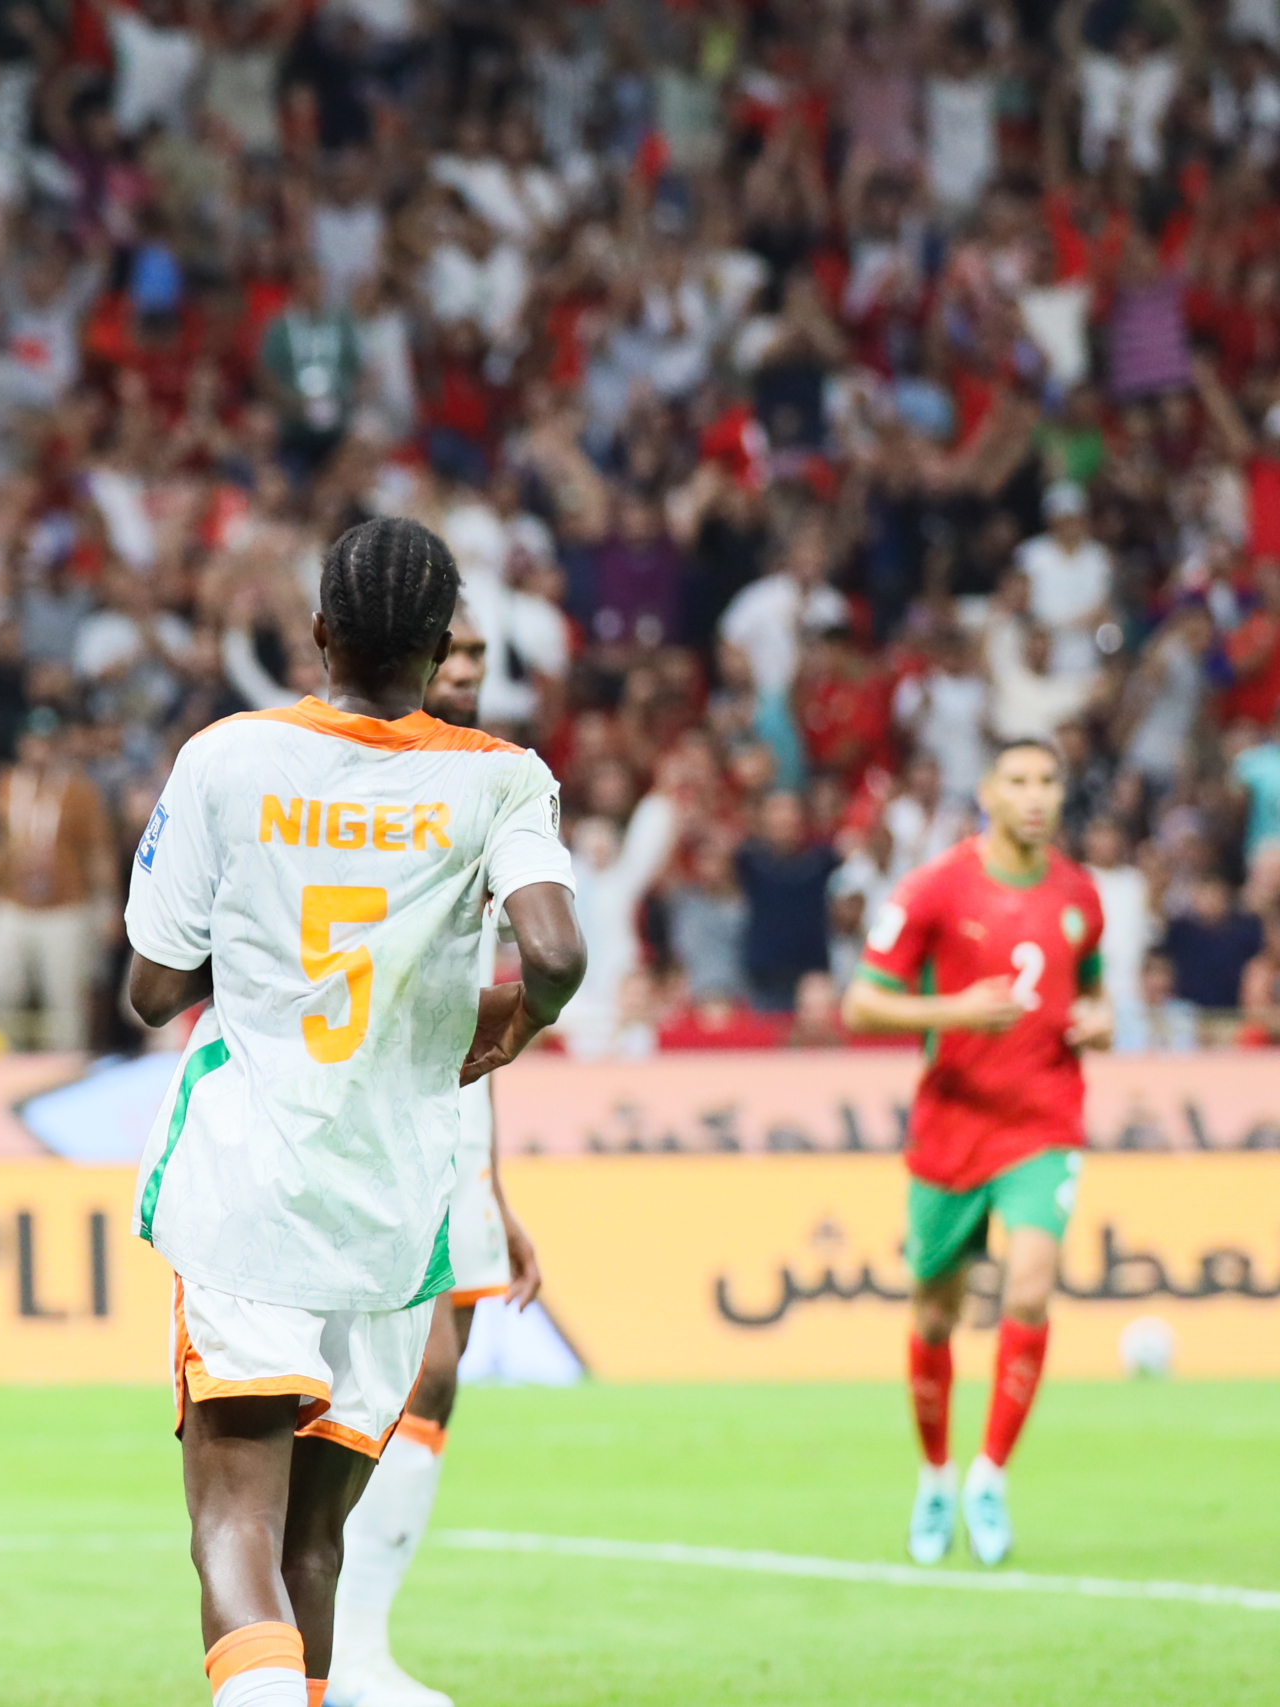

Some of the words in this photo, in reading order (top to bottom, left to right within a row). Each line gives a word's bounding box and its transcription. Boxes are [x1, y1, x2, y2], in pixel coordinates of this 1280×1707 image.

[258, 794, 451, 851] NIGER
[299, 884, 388, 1064] 5
[1010, 941, 1045, 1012] 2
